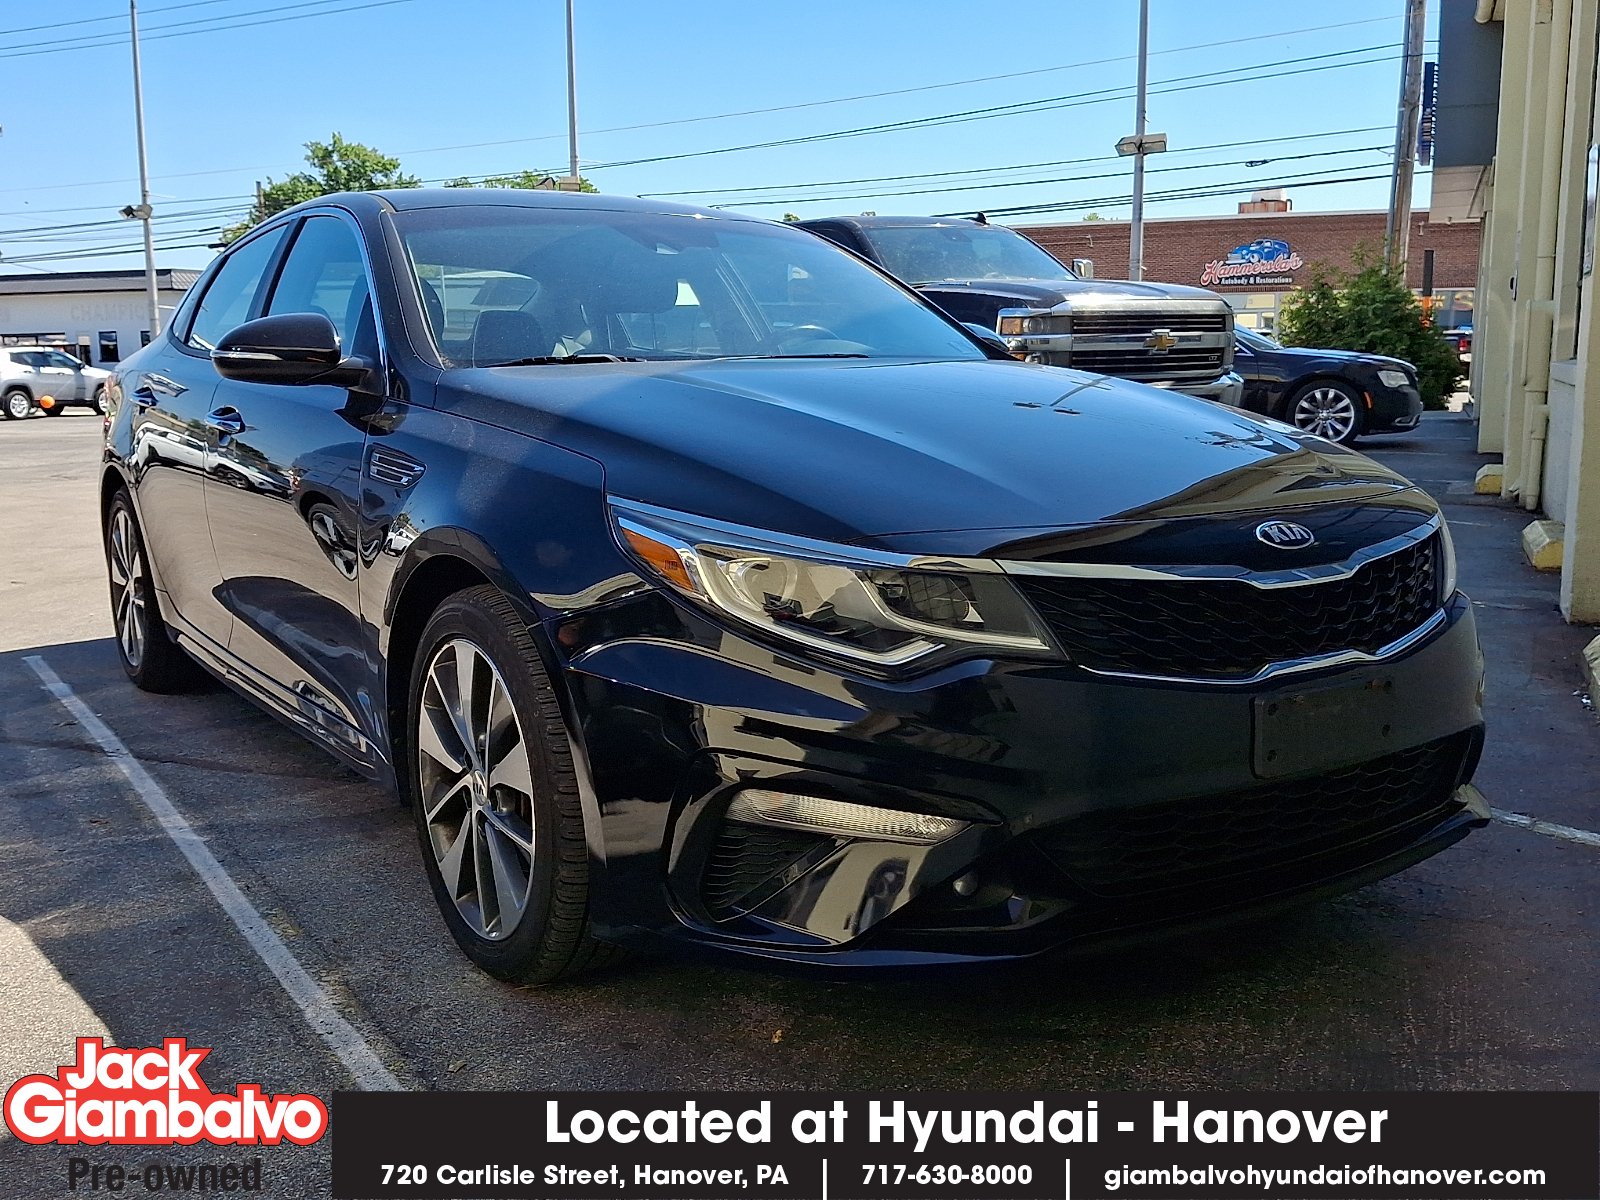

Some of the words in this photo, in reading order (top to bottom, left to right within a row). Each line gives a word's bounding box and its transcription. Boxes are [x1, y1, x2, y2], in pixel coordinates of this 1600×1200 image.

[1220, 277, 1248, 285] Autobody
[1255, 276, 1293, 284] Restorations
[1264, 524, 1309, 543] KIA
